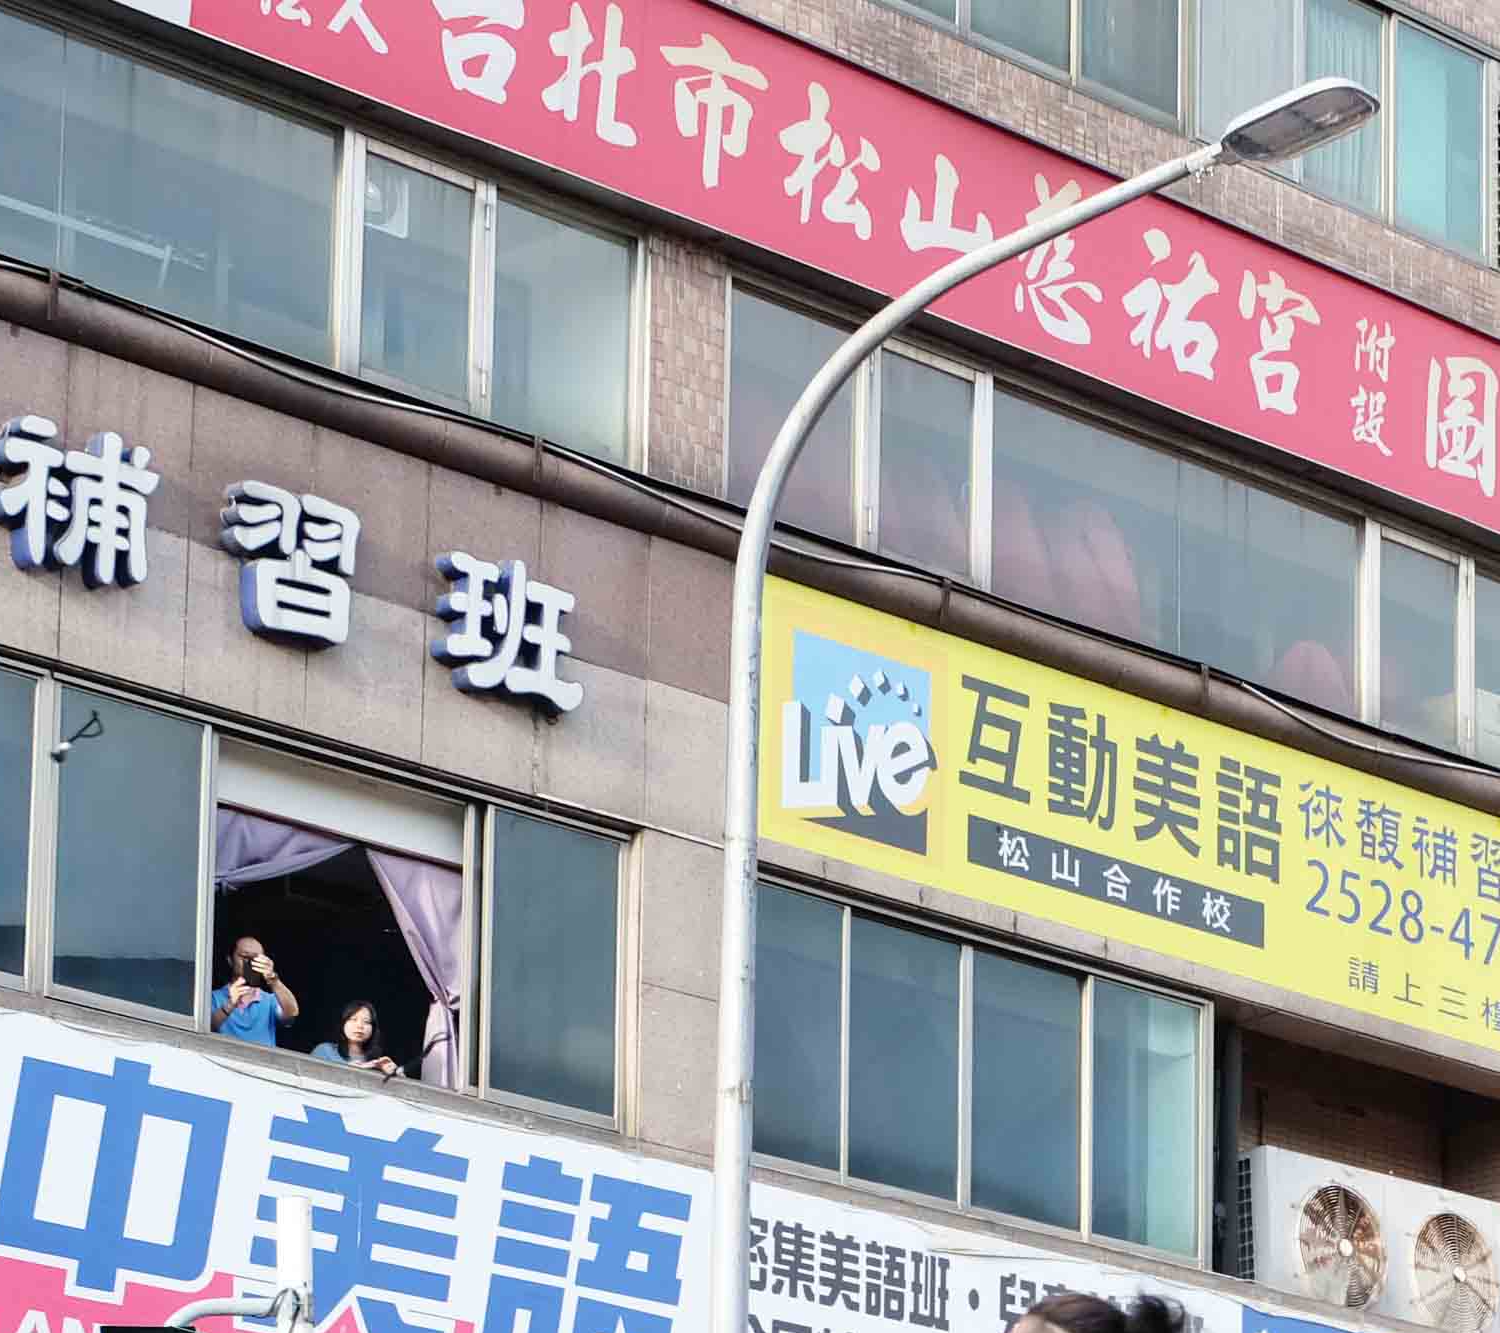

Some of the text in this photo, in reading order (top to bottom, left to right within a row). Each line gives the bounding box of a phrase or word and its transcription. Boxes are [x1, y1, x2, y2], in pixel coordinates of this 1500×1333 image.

[1348, 316, 1394, 459] 附設
[780, 697, 934, 817] Live
[958, 673, 1283, 884] 互動美語
[998, 828, 1232, 935] 松山合作校
